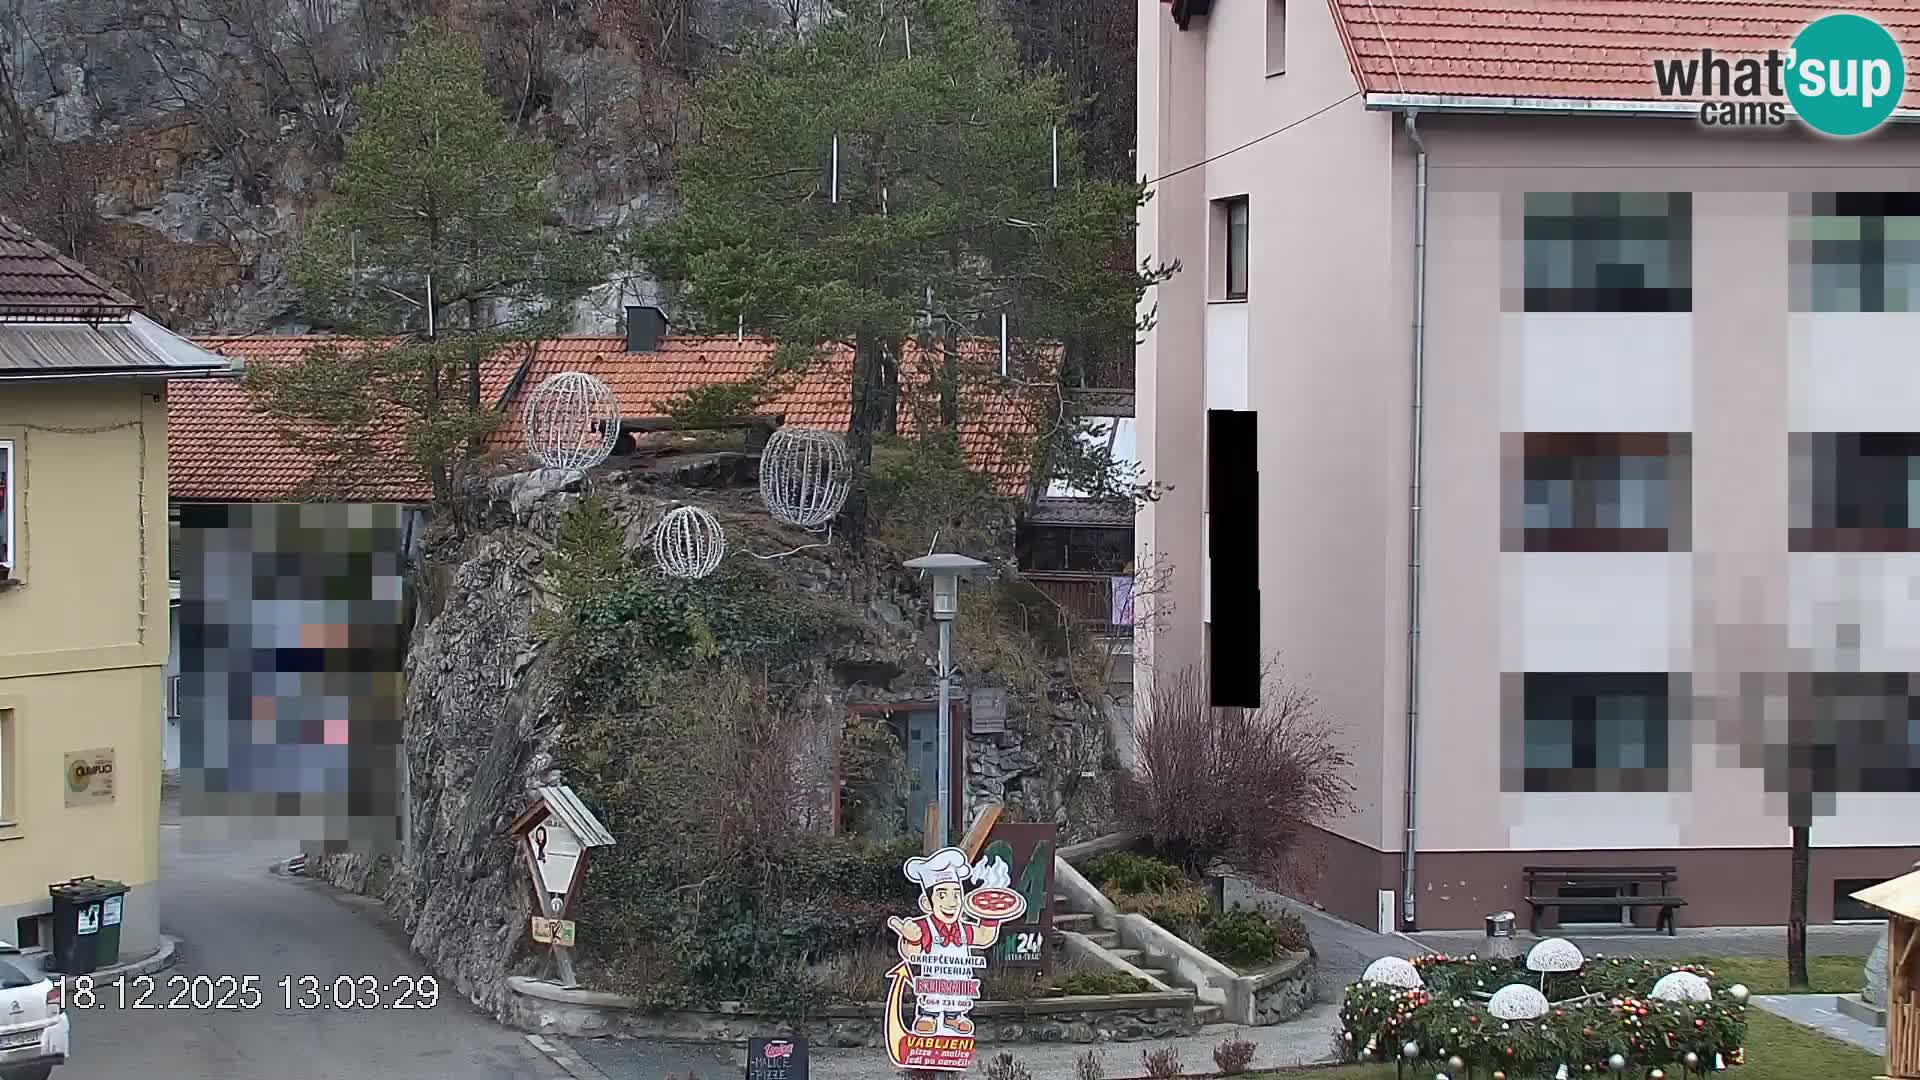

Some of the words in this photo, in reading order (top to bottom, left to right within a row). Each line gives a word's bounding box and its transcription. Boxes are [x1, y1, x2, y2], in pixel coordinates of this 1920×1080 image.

[910, 954, 985, 966] OKREPČEVALNICA
[923, 966, 932, 974] IN
[934, 967, 971, 976] PICERIJA
